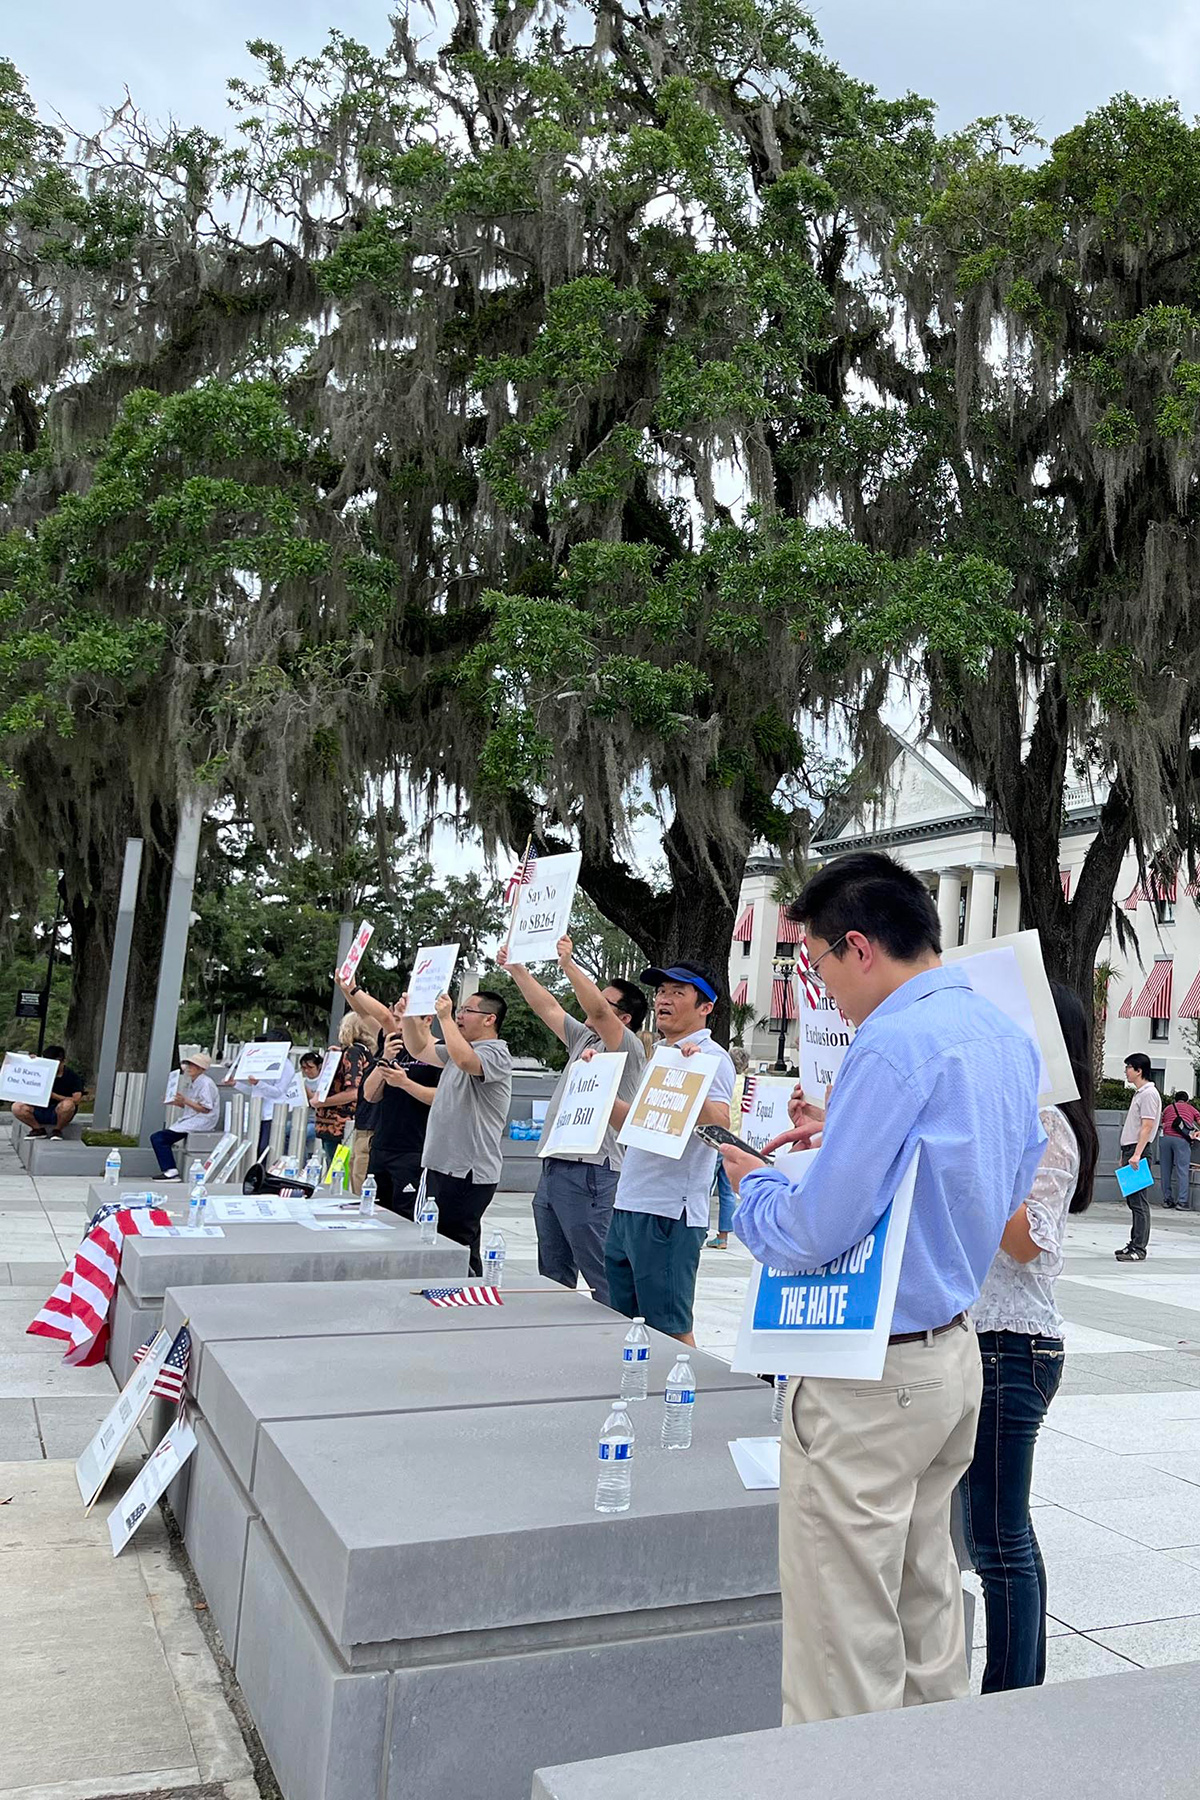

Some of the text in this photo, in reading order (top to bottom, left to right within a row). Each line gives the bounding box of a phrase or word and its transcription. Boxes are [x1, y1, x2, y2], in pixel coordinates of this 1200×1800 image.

[527, 886, 556, 906] Say No
[519, 912, 556, 931] to SB264
[805, 1024, 850, 1046] Exclusion
[662, 1069, 688, 1089] EQUAL
[814, 1061, 834, 1084] Law
[577, 1074, 599, 1093] Anti-
[643, 1087, 689, 1112] PROTECTION
[572, 1108, 595, 1125] Bill
[643, 1110, 660, 1129] FOR
[756, 1101, 774, 1122] Equal
[779, 1285, 848, 1325] THE HATE
